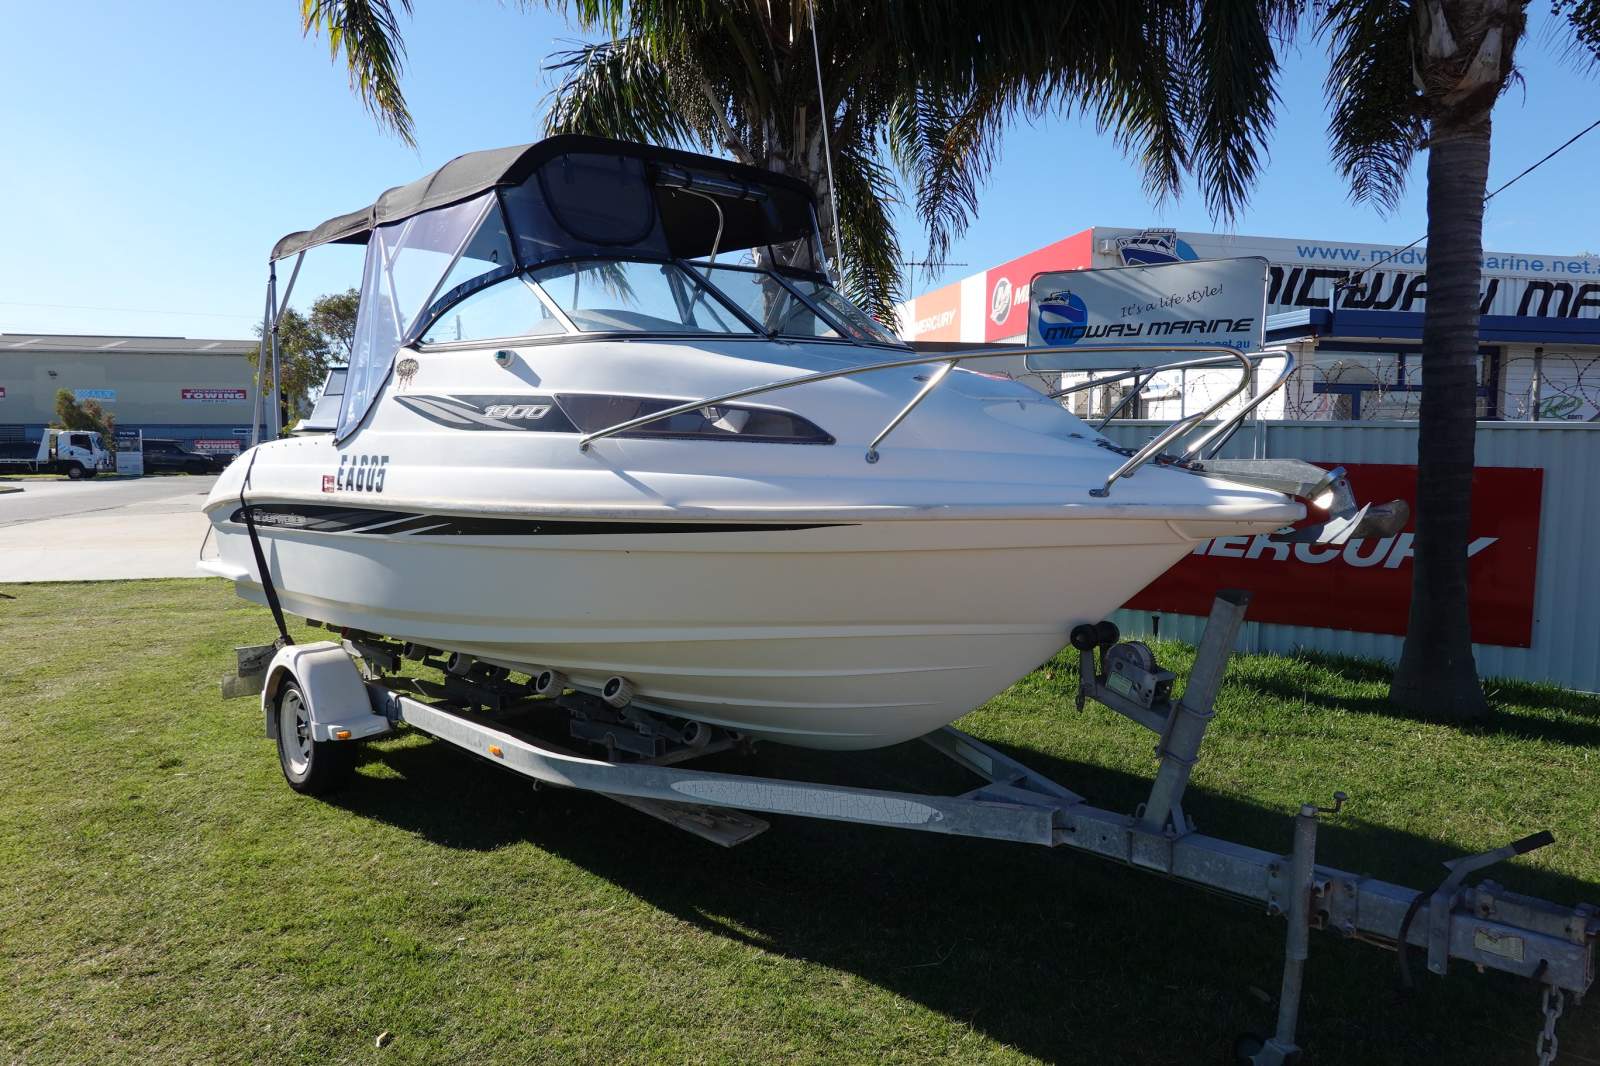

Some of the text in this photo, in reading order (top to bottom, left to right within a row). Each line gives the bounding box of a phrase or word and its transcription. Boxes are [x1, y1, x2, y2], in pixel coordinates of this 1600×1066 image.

[1120, 283, 1224, 319] It's a life style!
[1043, 317, 1255, 341] MIDWAY MARINE
